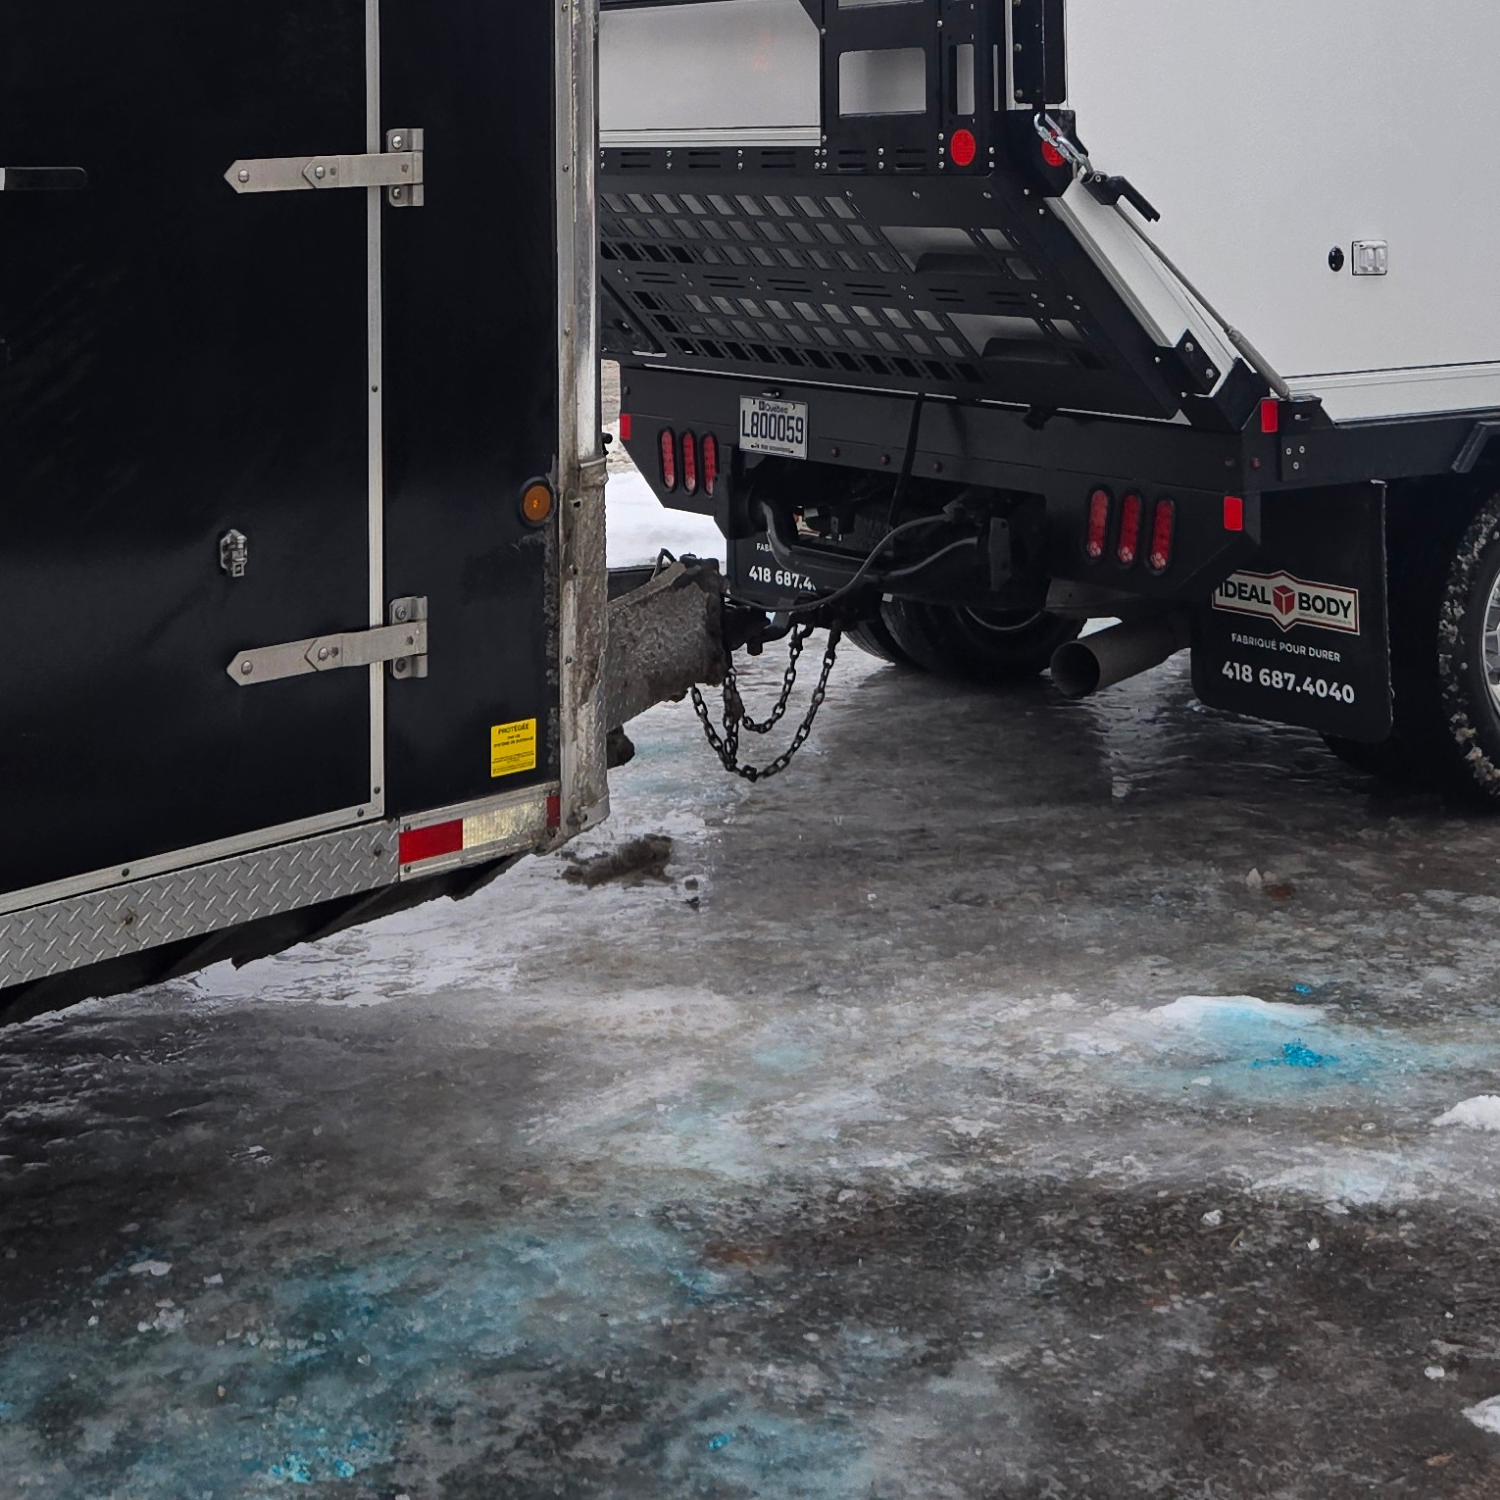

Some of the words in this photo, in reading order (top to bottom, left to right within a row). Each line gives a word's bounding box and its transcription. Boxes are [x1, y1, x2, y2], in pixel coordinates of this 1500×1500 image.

[742, 409, 804, 445] L800059
[748, 565, 772, 583] 418
[775, 570, 817, 591] 687.4
[1218, 581, 1272, 605] IDEAL
[1297, 592, 1352, 619] BODY
[1231, 632, 1277, 651] FABRIQUÉ
[1279, 641, 1306, 656] POUR
[1308, 647, 1341, 663] DURER
[1221, 660, 1253, 683] 418
[1259, 668, 1355, 704] 687.4040
